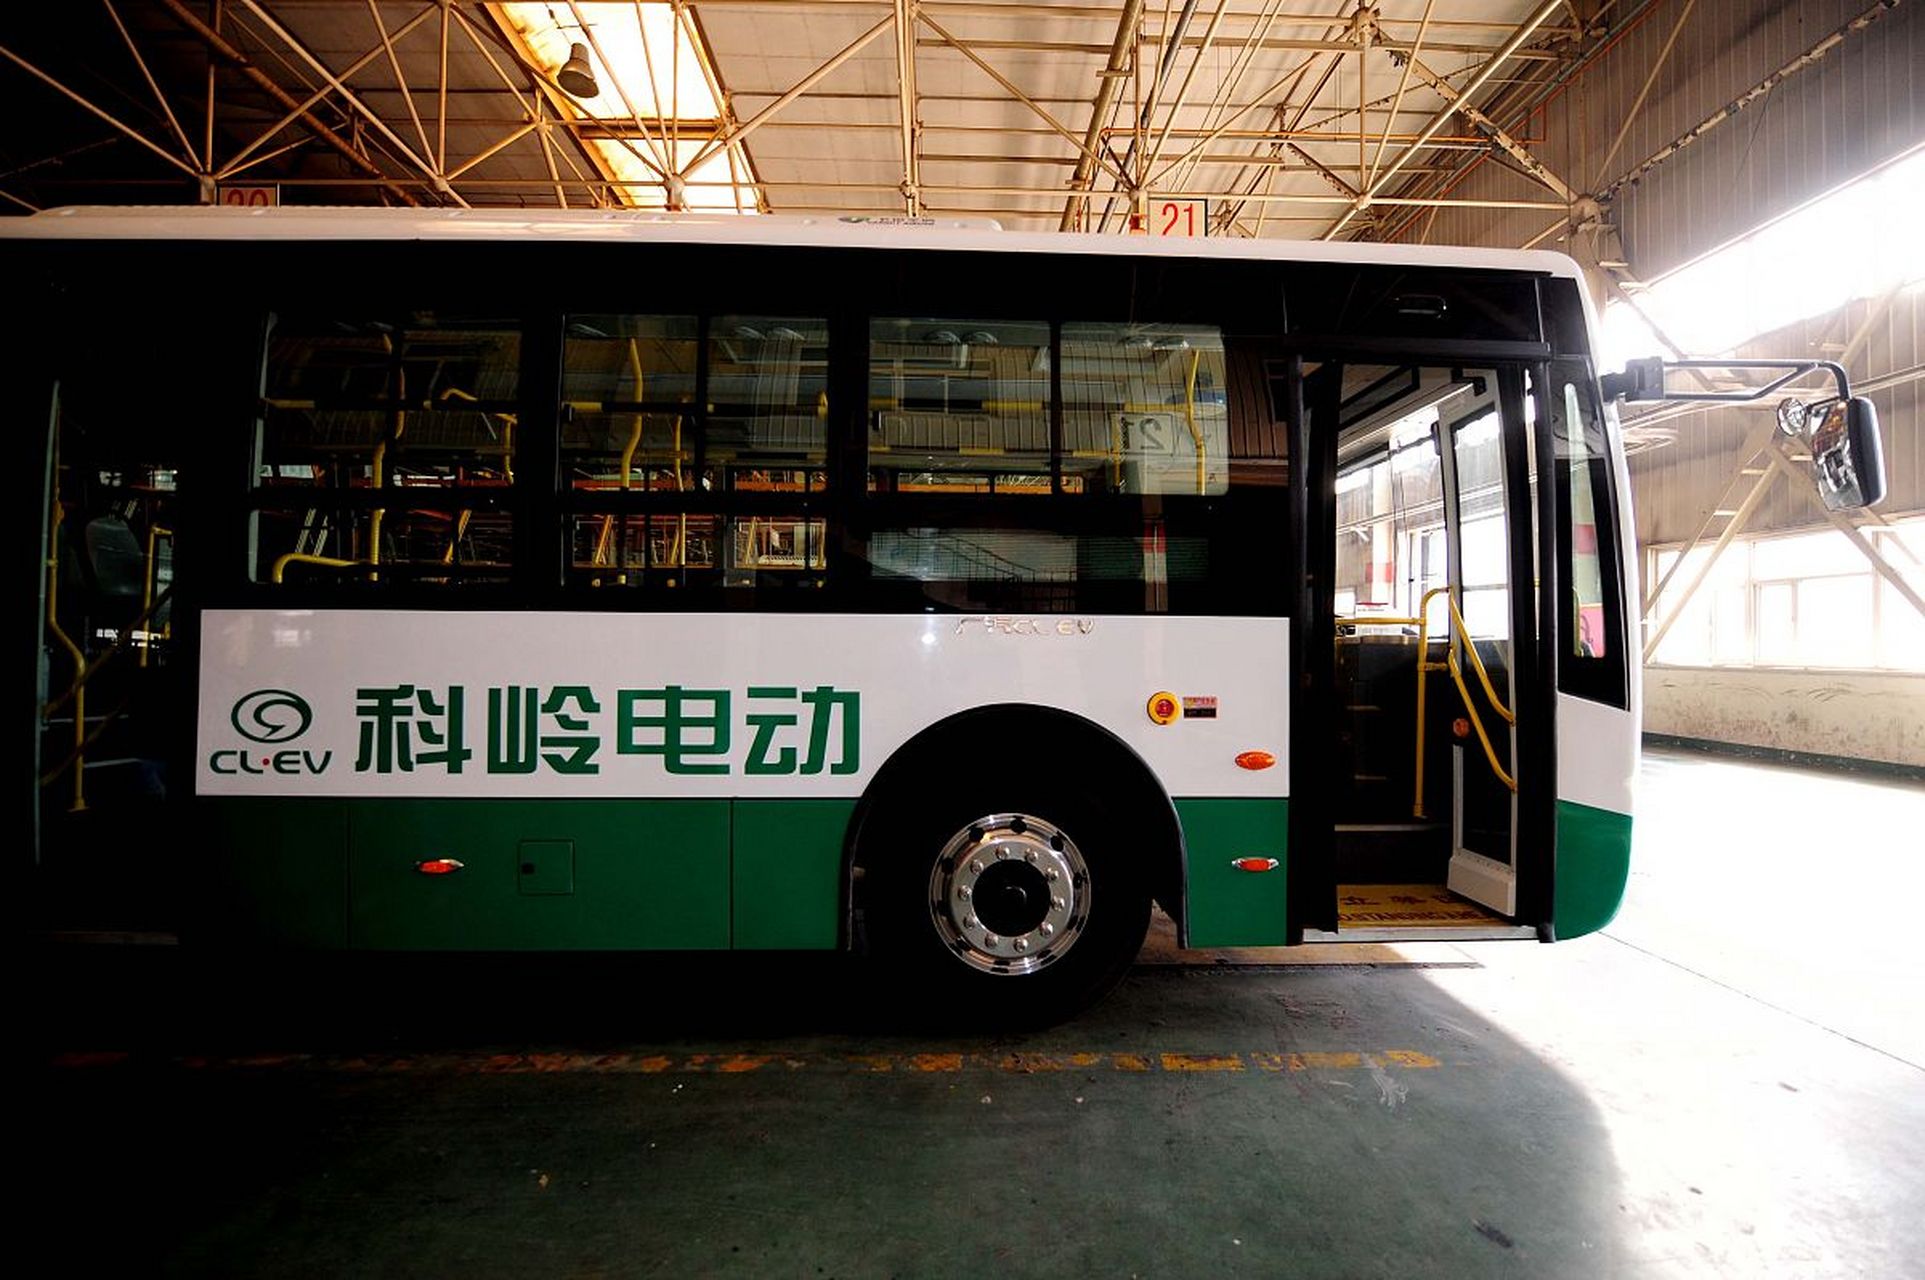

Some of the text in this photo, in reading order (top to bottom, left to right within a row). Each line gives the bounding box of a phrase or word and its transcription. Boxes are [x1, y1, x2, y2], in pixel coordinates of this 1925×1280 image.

[1162, 203, 1193, 236] 21
[355, 684, 861, 775] 科岭电动
